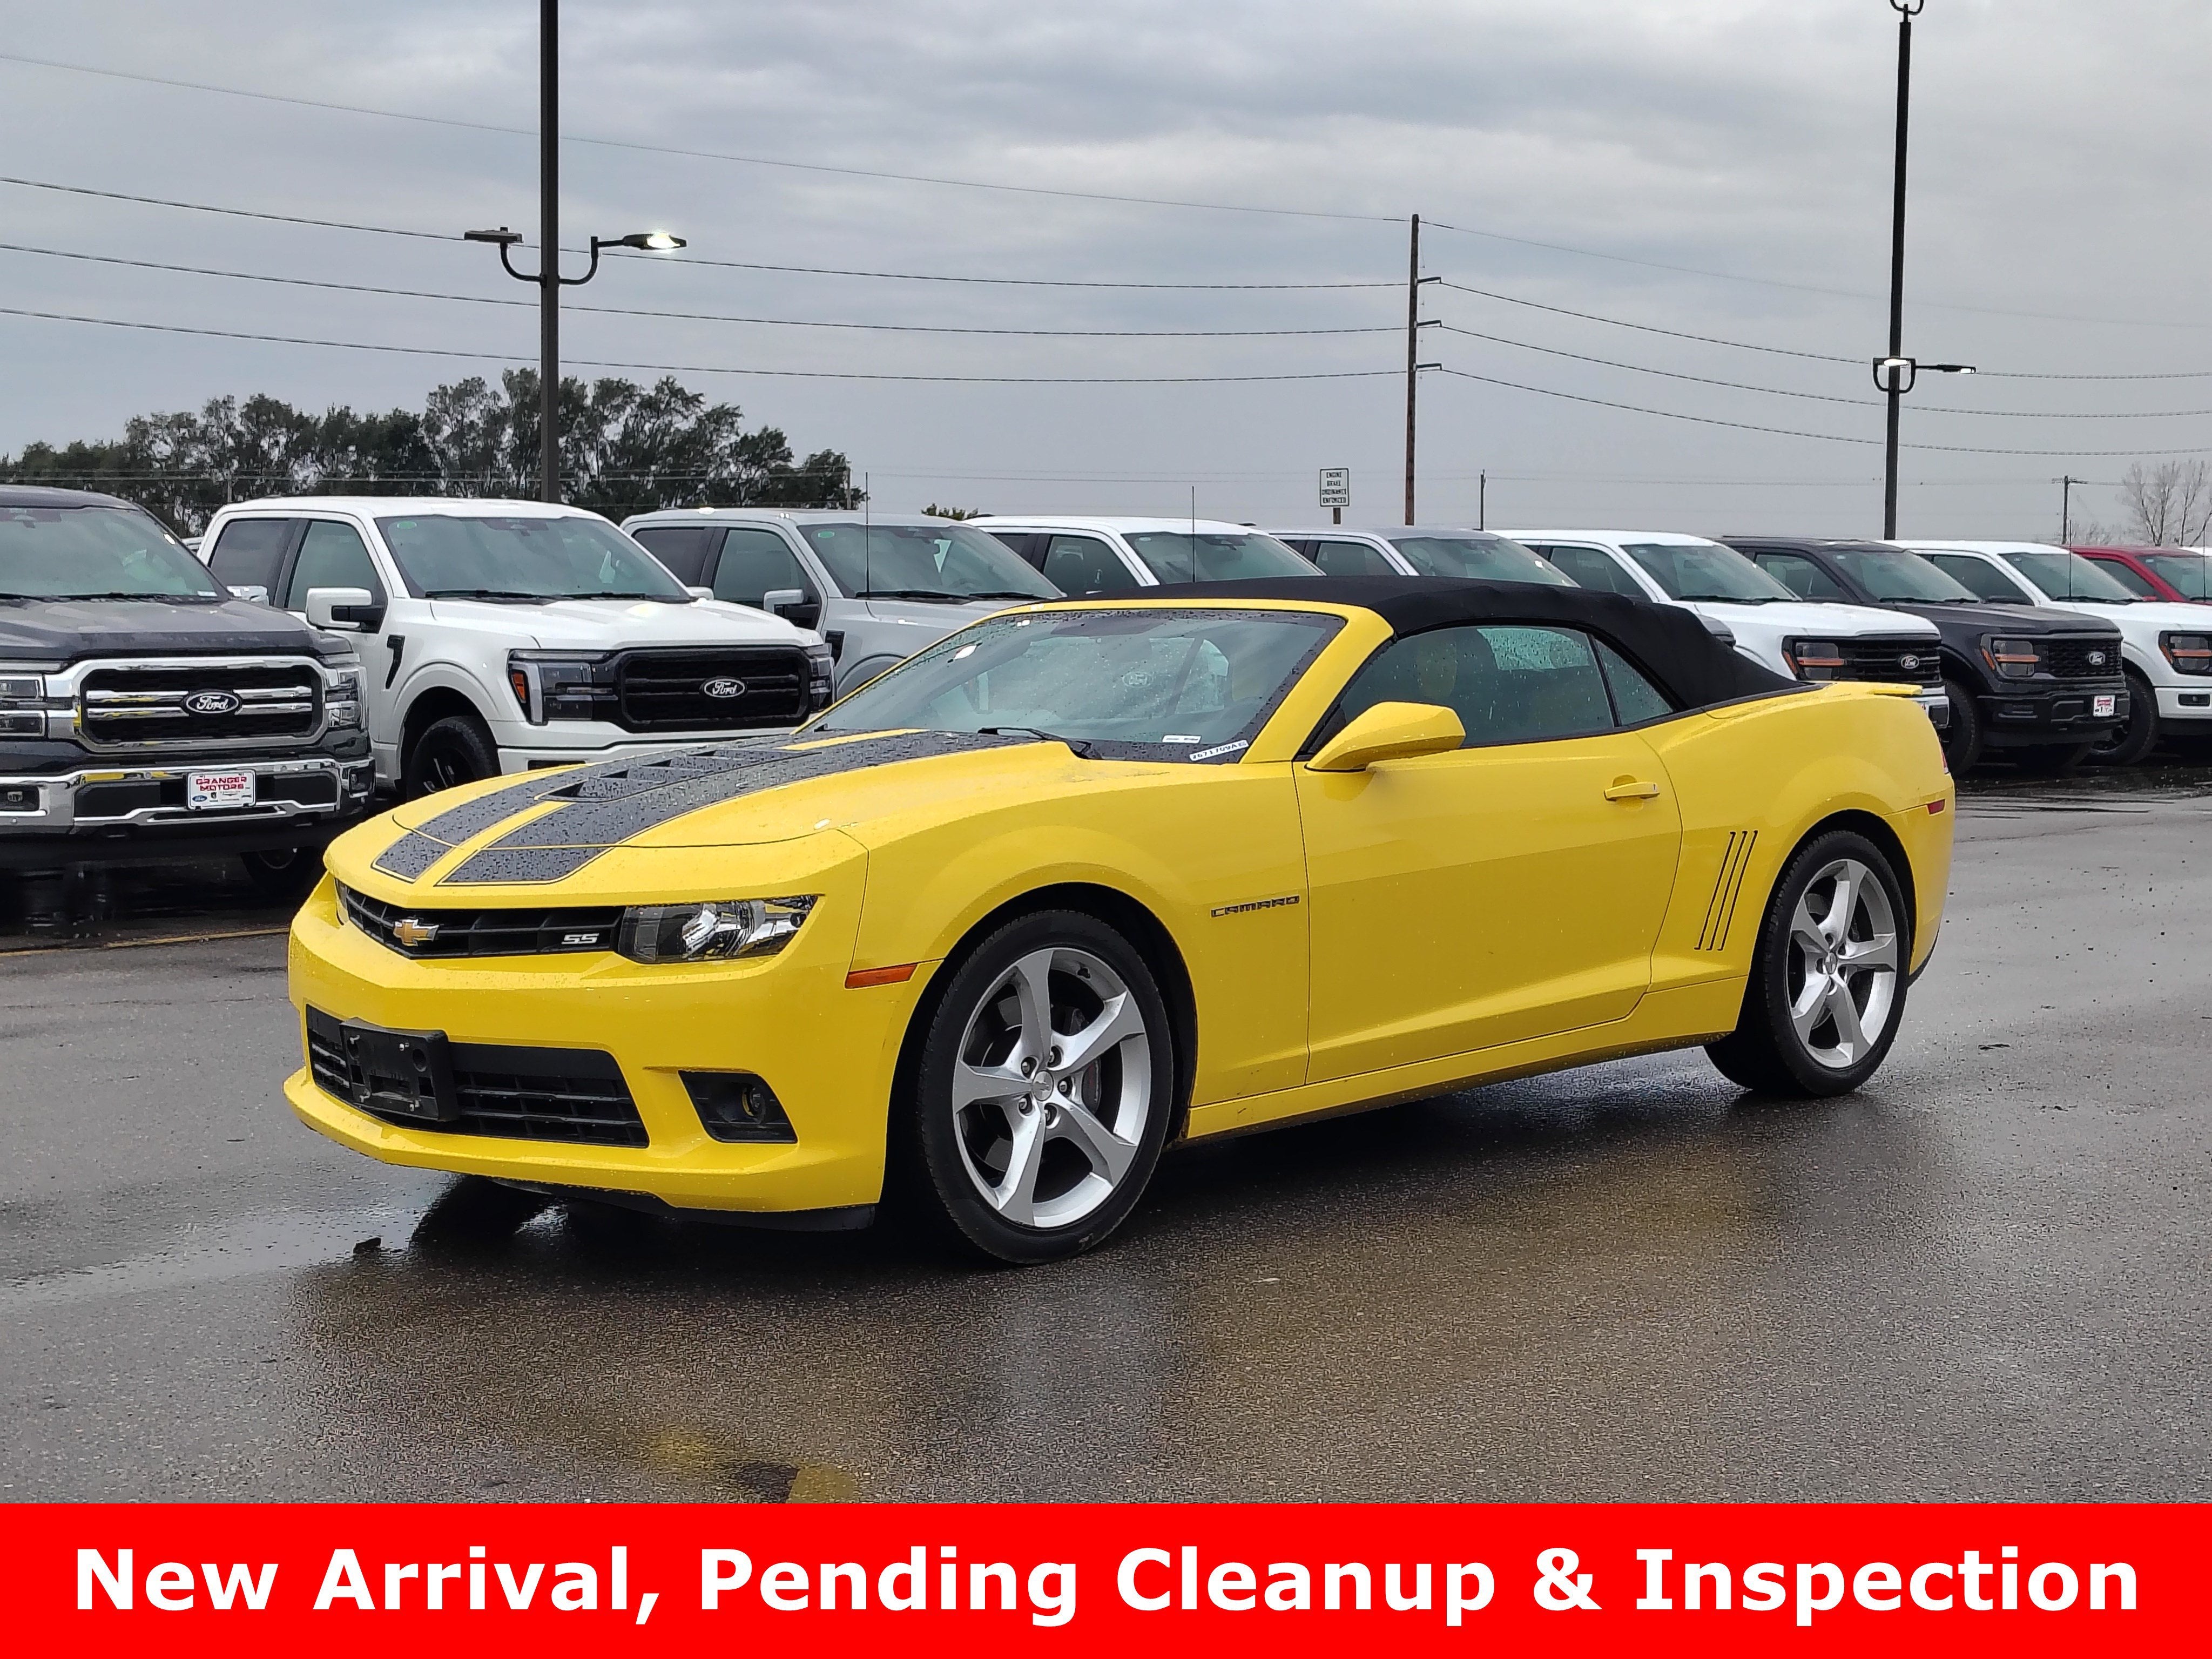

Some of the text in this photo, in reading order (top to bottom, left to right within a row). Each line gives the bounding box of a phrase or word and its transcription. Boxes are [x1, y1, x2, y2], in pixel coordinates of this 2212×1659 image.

[712, 681, 737, 695] Ford
[196, 695, 229, 710] Ford
[195, 777, 247, 785] GRANGER
[199, 784, 244, 792] MOTORS
[1211, 895, 1300, 918] CAMARO
[561, 933, 599, 945] SS
